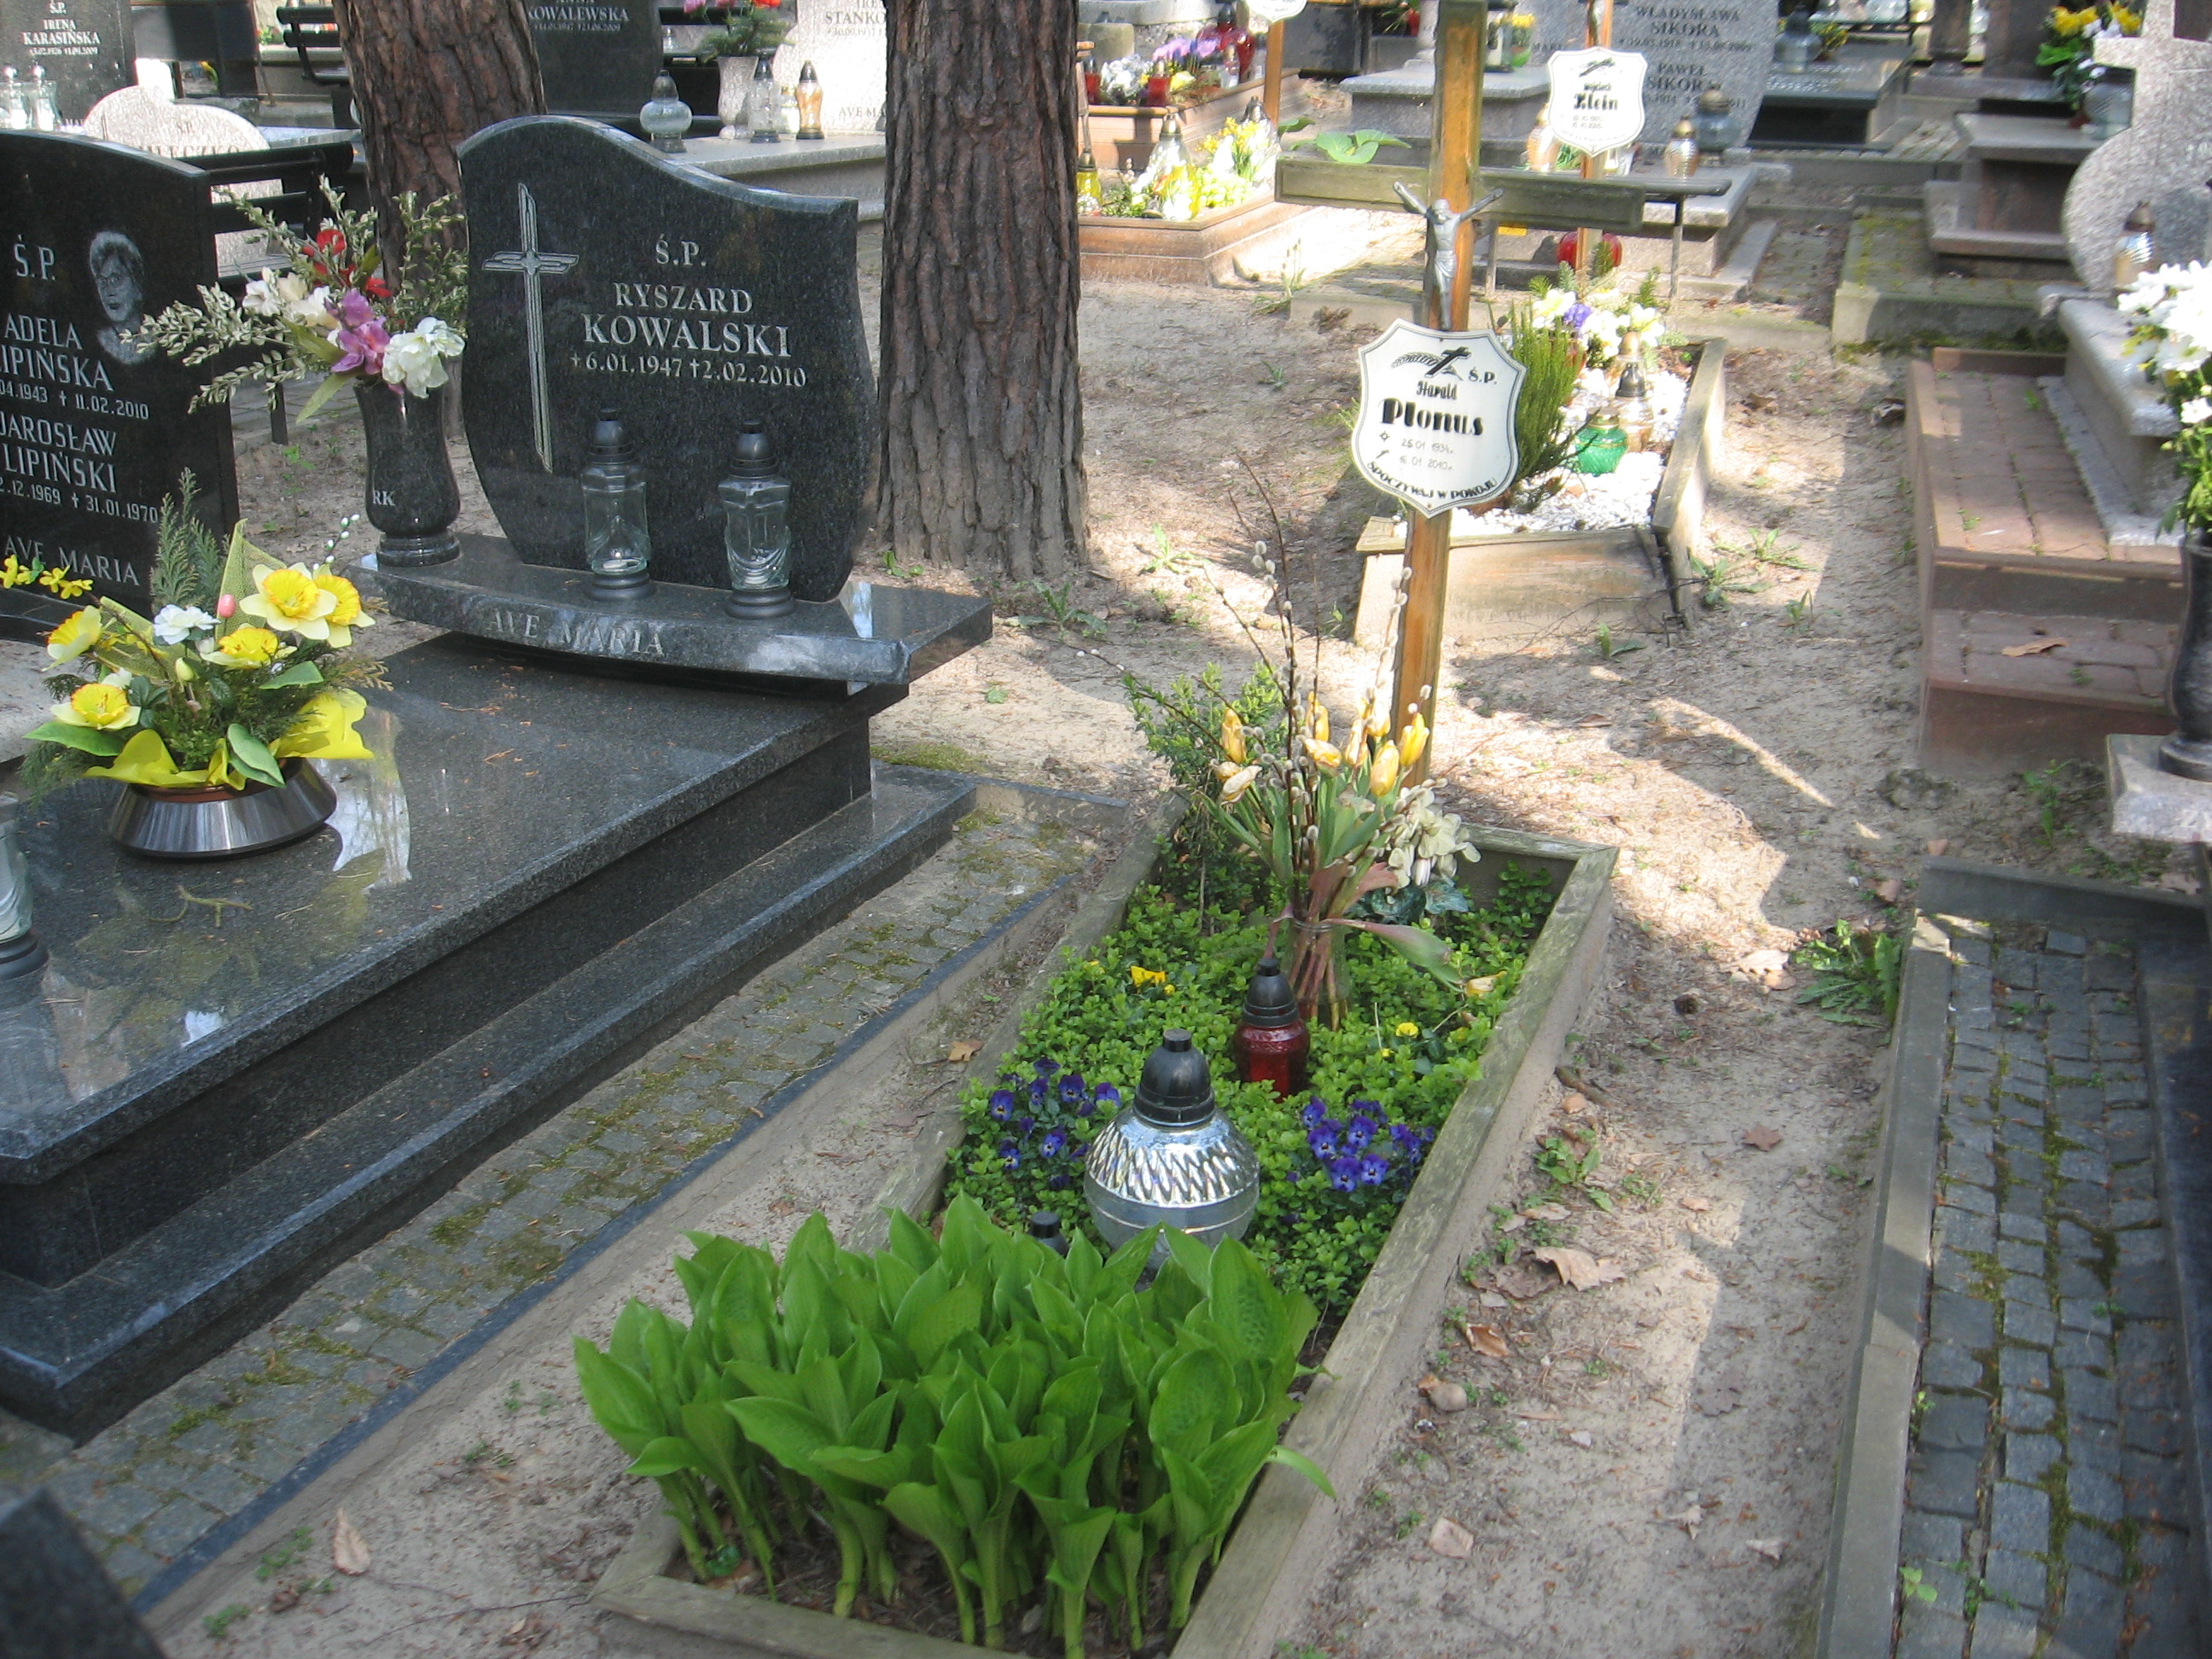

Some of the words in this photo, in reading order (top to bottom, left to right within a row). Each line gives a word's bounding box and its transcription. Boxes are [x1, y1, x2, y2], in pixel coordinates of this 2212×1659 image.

[21, 29, 101, 45] KARASIŃSKA
[1651, 20, 1720, 38] SIKORA
[14, 234, 57, 281] Ś.P.
[655, 234, 707, 267] Ś.P.
[614, 282, 753, 314] RYSZARD
[4, 312, 83, 350] ADELA
[581, 313, 792, 358] KOWALSKI
[0, 344, 114, 393] IPIŃSKA
[1468, 366, 1498, 385] Ś.P.
[75, 393, 149, 420] 11.02.2010
[1416, 380, 1458, 400] Harald
[0, 410, 117, 457] JAROSŁAW
[1378, 397, 1484, 436] Plonus
[3, 443, 117, 493] LIPIŃSKI
[1367, 461, 1435, 498] SPOCZYWAJ
[1437, 490, 1448, 499] W
[1450, 477, 1498, 500] POKOJU
[85, 494, 159, 523] 31.01.1970
[372, 488, 396, 507] RK
[58, 546, 140, 586] MARIA
[486, 608, 540, 640] AVE
[561, 619, 666, 659] MARIA
